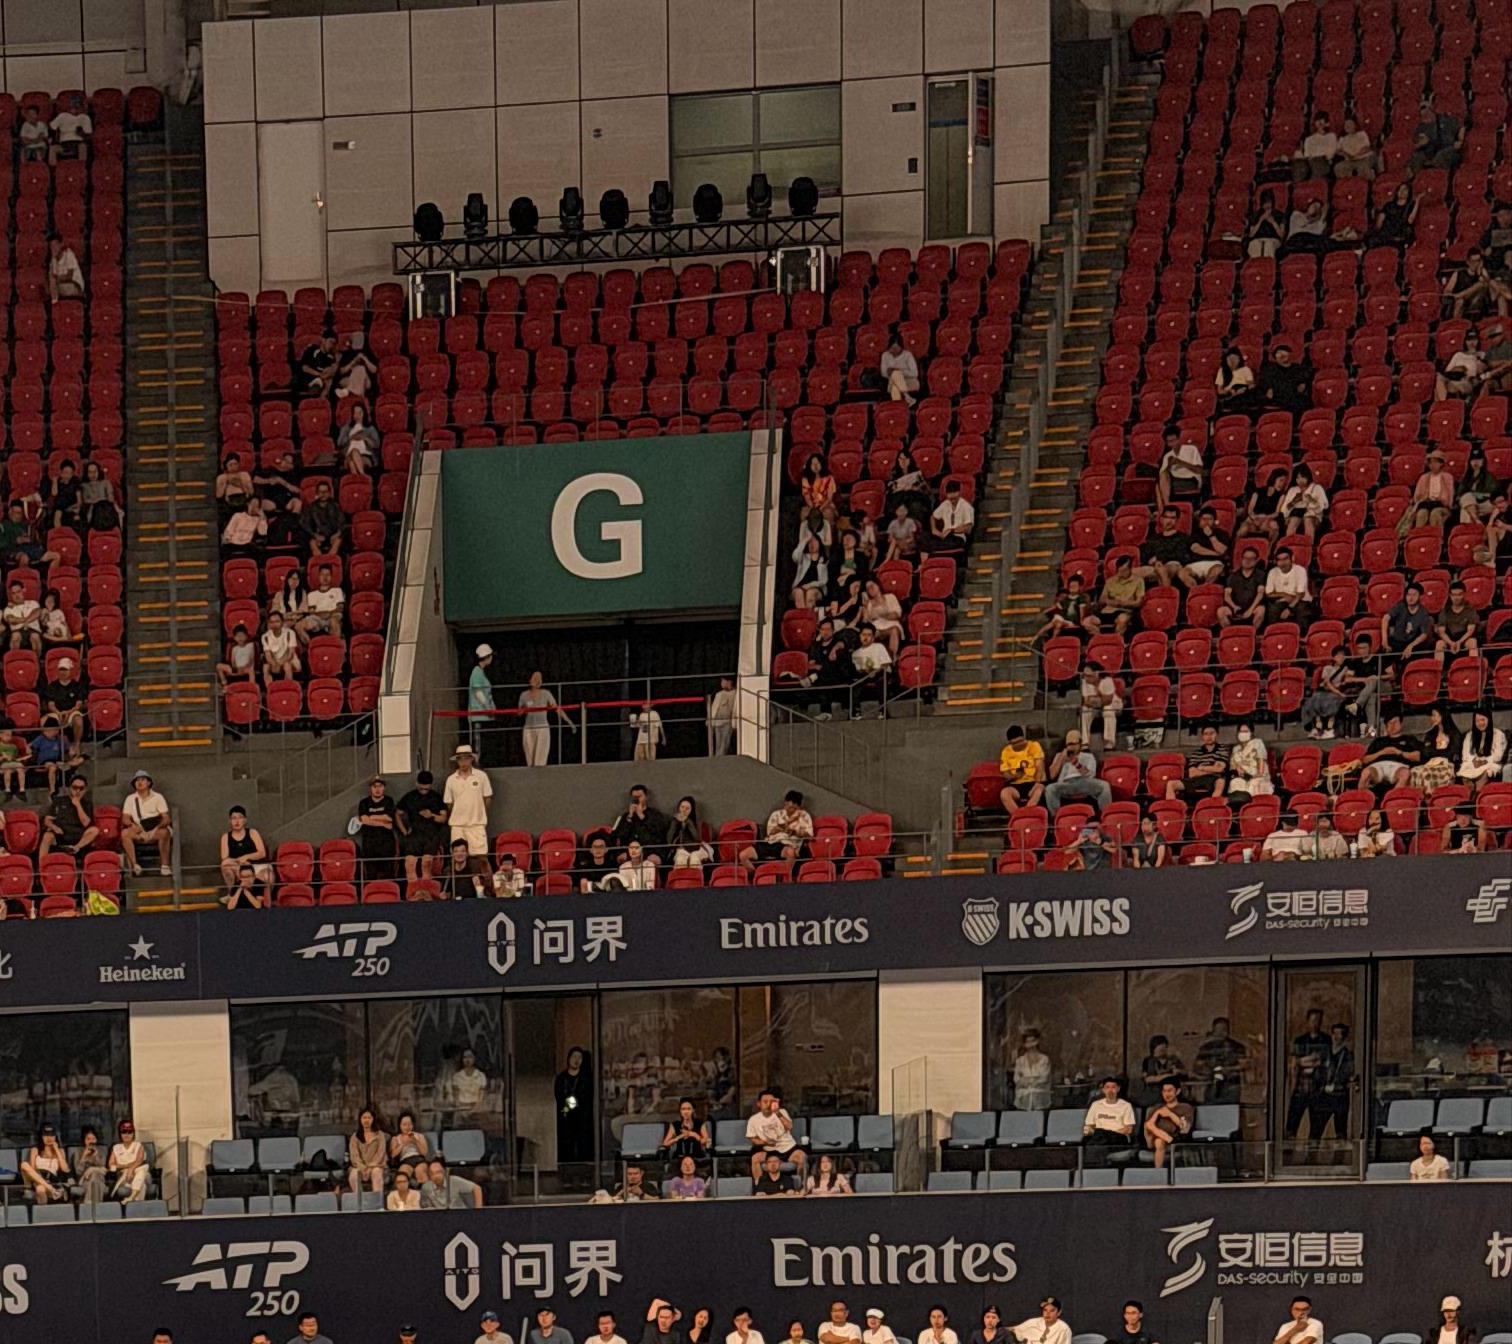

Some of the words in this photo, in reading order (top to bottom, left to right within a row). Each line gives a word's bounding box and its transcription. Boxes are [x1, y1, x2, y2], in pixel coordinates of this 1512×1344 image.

[551, 472, 644, 580] G
[1266, 889, 1369, 918] 安恒信息
[292, 921, 398, 960] ATP
[533, 915, 629, 965] 问界
[719, 913, 870, 950] Emirates
[99, 963, 187, 983] Heineken
[351, 957, 391, 977] 250
[161, 1240, 310, 1291] ATP
[769, 1232, 1018, 1288] Emirates
[1217, 1231, 1364, 1269] 安恒信息
[500, 1239, 624, 1300] 问界
[1217, 1270, 1309, 1289] DAS-security
[245, 1289, 301, 1317] 250
